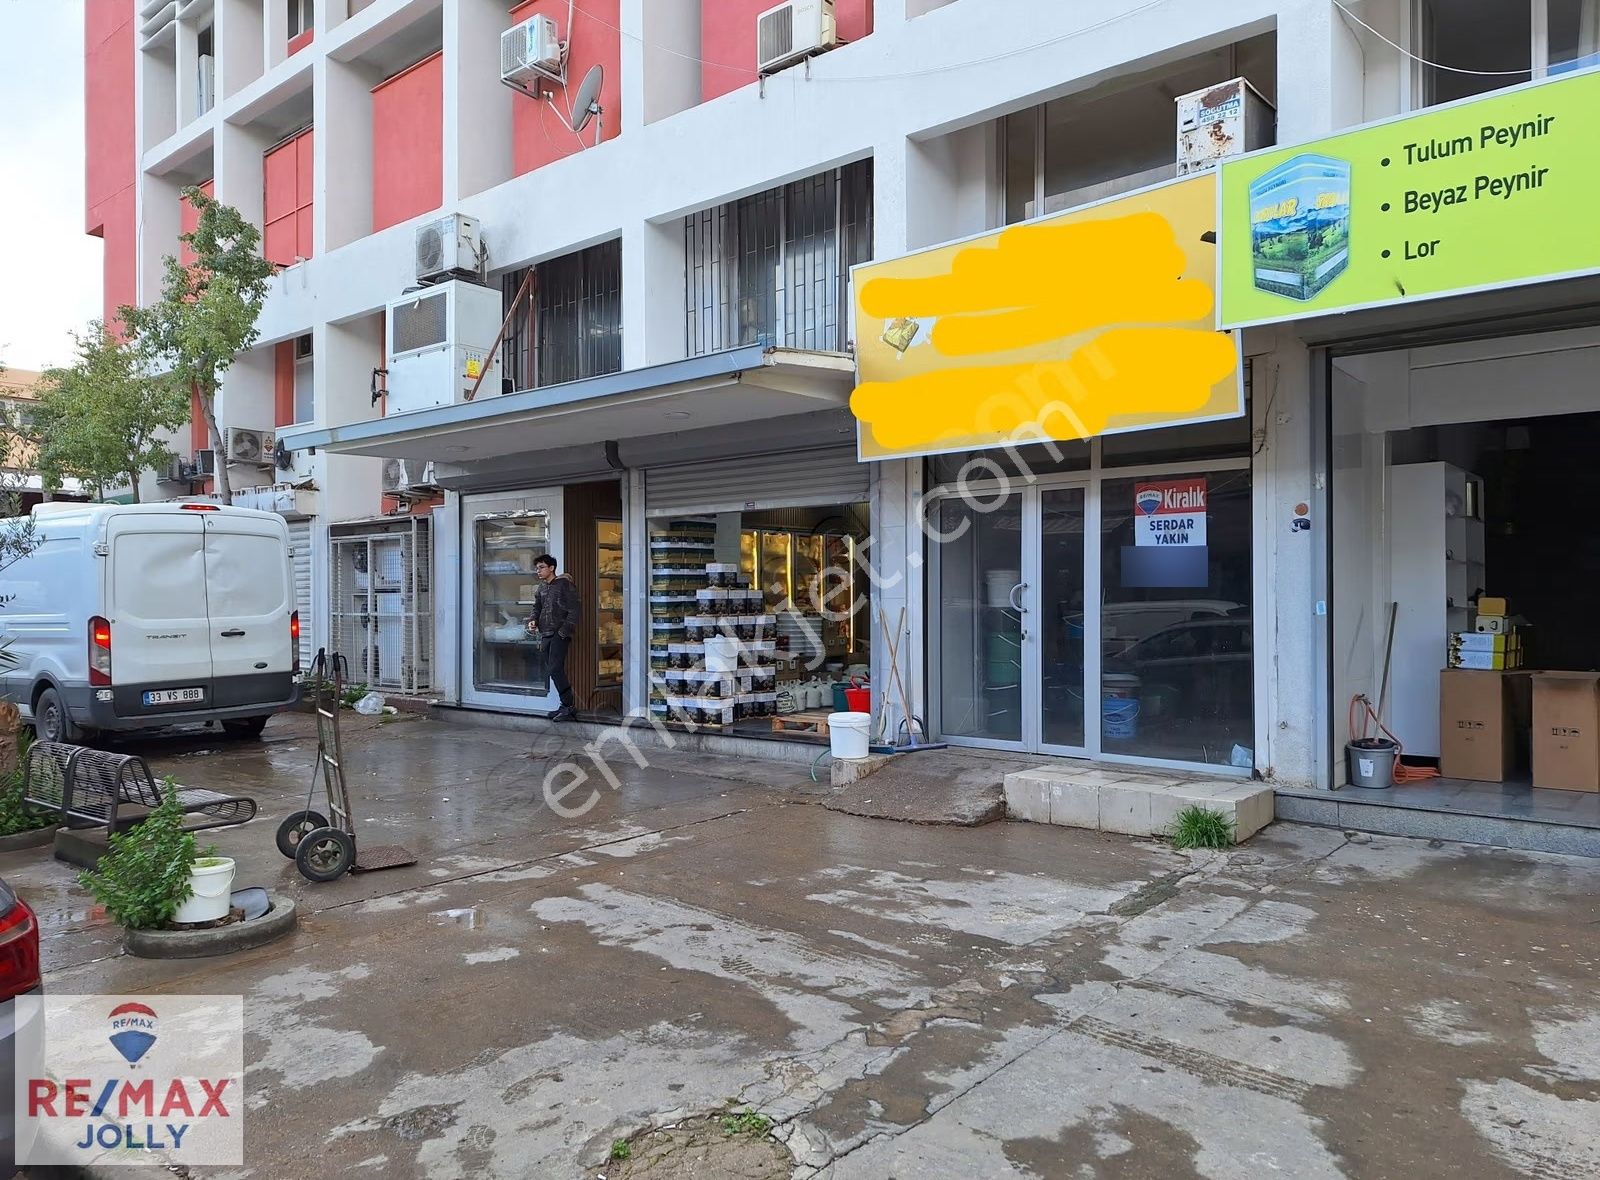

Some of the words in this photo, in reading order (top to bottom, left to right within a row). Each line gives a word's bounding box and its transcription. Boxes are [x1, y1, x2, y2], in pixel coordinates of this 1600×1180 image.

[1403, 139, 1473, 165] Tulum
[1480, 113, 1555, 149] Peynir
[1404, 185, 1467, 214] Beyaz
[1474, 164, 1549, 200] Peynir
[1404, 239, 1441, 260] Lor
[1164, 485, 1205, 509] Kiralık
[1149, 518, 1194, 531] SERDAR
[1154, 533, 1189, 545] YAKIN
[150, 691, 162, 702] 33
[166, 690, 178, 701] VS
[182, 689, 199, 700] 888
